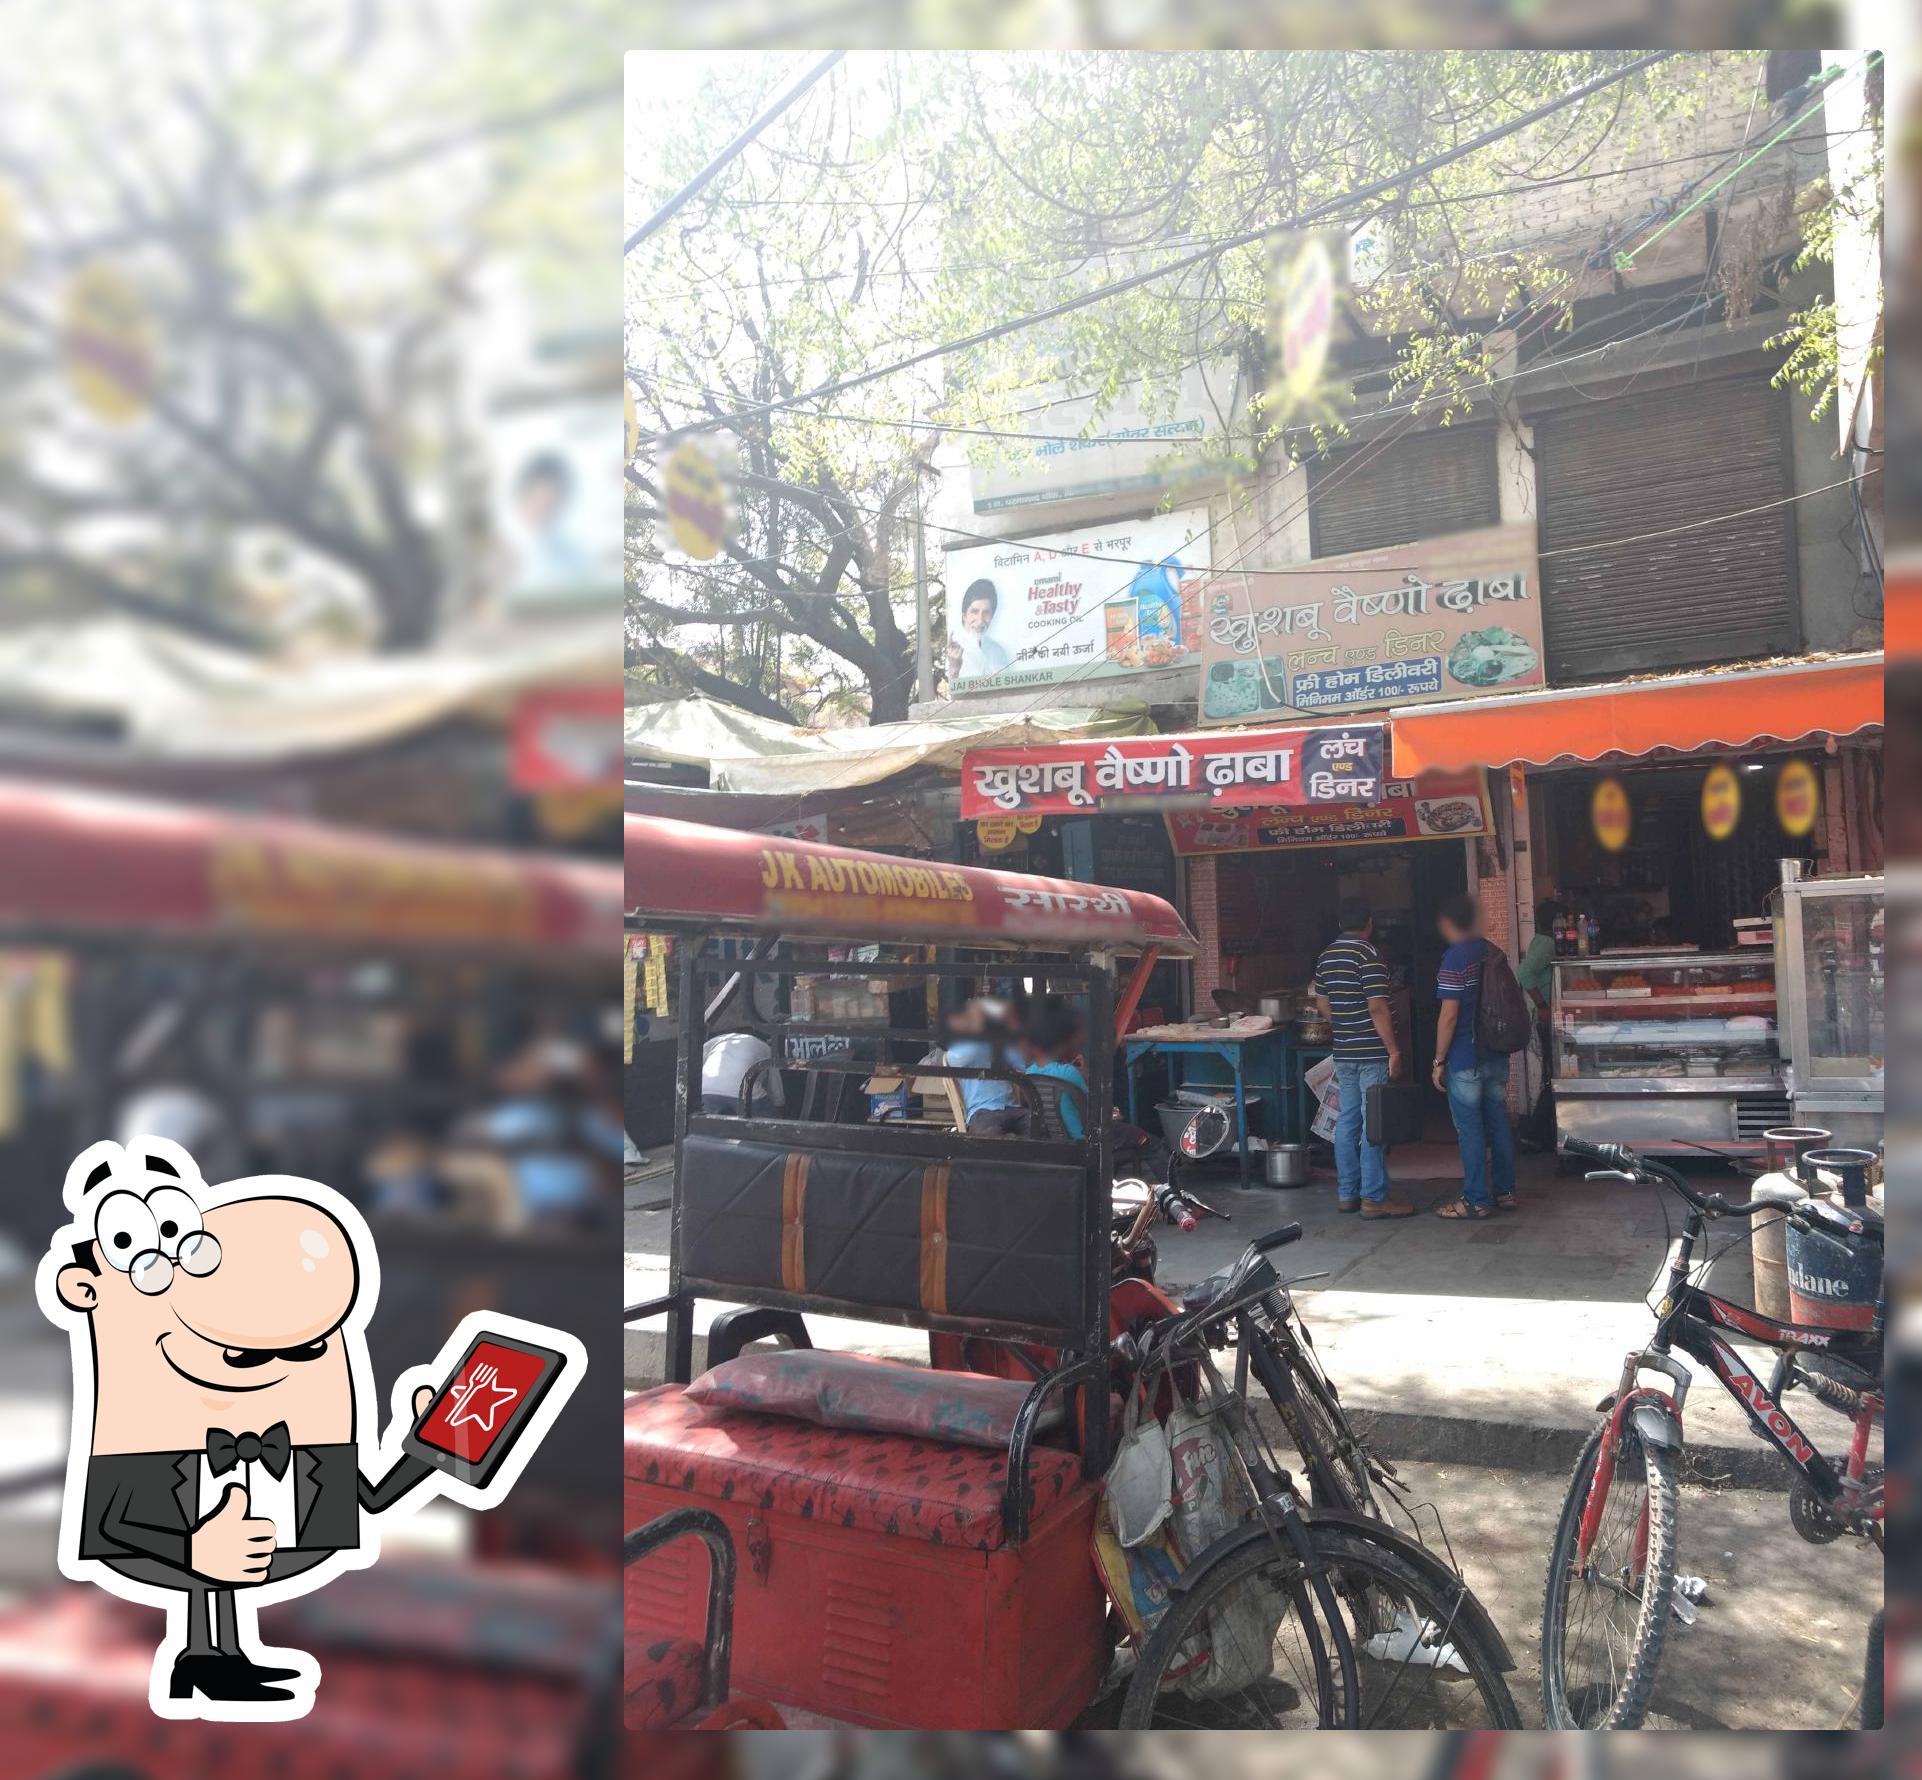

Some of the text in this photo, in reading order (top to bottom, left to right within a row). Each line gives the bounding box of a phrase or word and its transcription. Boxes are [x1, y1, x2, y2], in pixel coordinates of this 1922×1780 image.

[994, 552, 1030, 568] विटामिन
[1082, 543, 1090, 554] E
[1028, 581, 1083, 601] Healthy
[1028, 614, 1085, 629] COOKING OIL
[1210, 602, 1332, 655] खुशबू
[1331, 574, 1433, 625] वैष्णो
[1073, 639, 1095, 655] ऊर्जा
[1288, 645, 1341, 672] लन्च
[1384, 629, 1446, 659] डिनर
[950, 671, 1054, 692] JAI BHOLE SHANKAR
[1295, 658, 1438, 693] फ्री होम डिलीवरी
[1295, 690, 1341, 708] मिनिमम
[1378, 685, 1405, 698] 100/-
[1320, 731, 1366, 760] लंच
[973, 743, 1294, 810] खुशबू वैष्णो ढ़ाबा
[1331, 761, 1354, 773] एण्ड
[1308, 771, 1377, 800] डिनर
[761, 850, 974, 901] JK AUTOMOBILES
[1788, 1262, 1849, 1297] ndane
[1777, 1328, 1831, 1348] TRAXX
[1729, 1373, 1814, 1464] AVON
